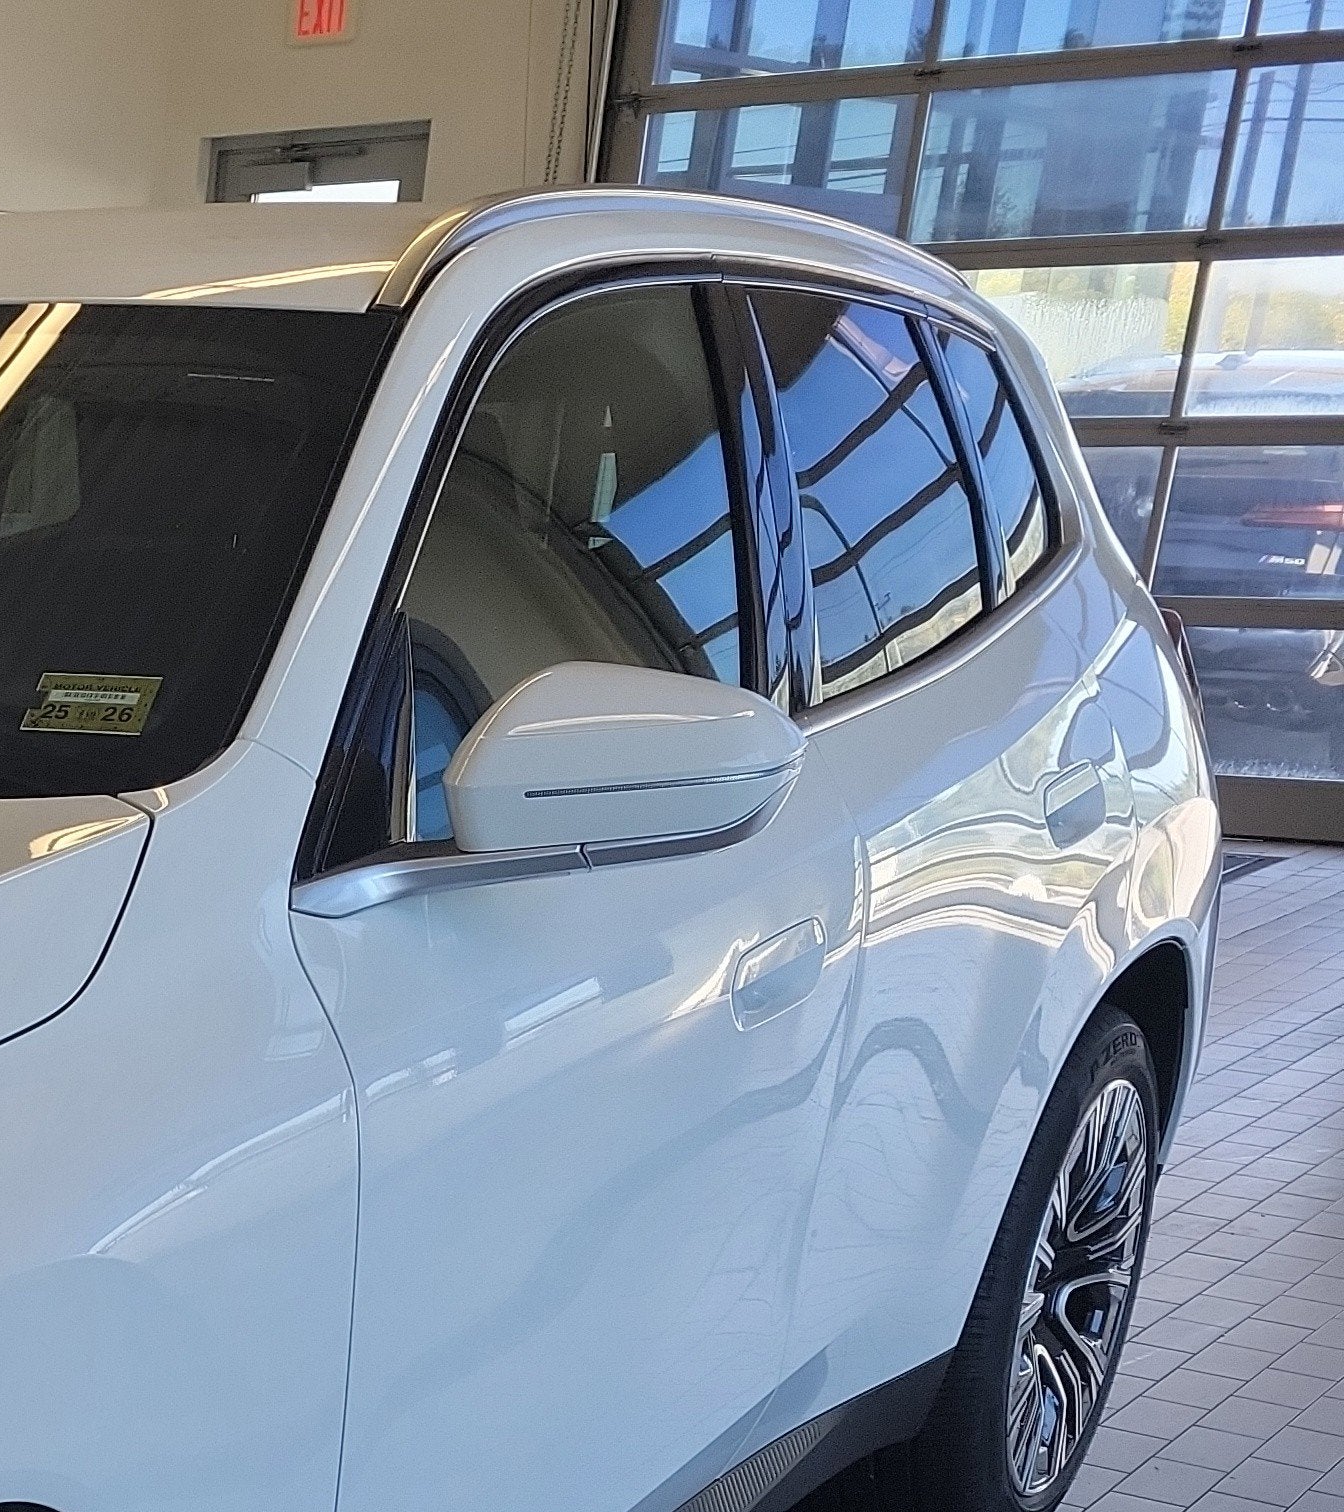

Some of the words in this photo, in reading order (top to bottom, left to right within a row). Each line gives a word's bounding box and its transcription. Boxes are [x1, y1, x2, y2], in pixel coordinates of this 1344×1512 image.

[298, 0, 346, 36] EXIT
[40, 703, 71, 720] 25
[100, 706, 135, 723] 26
